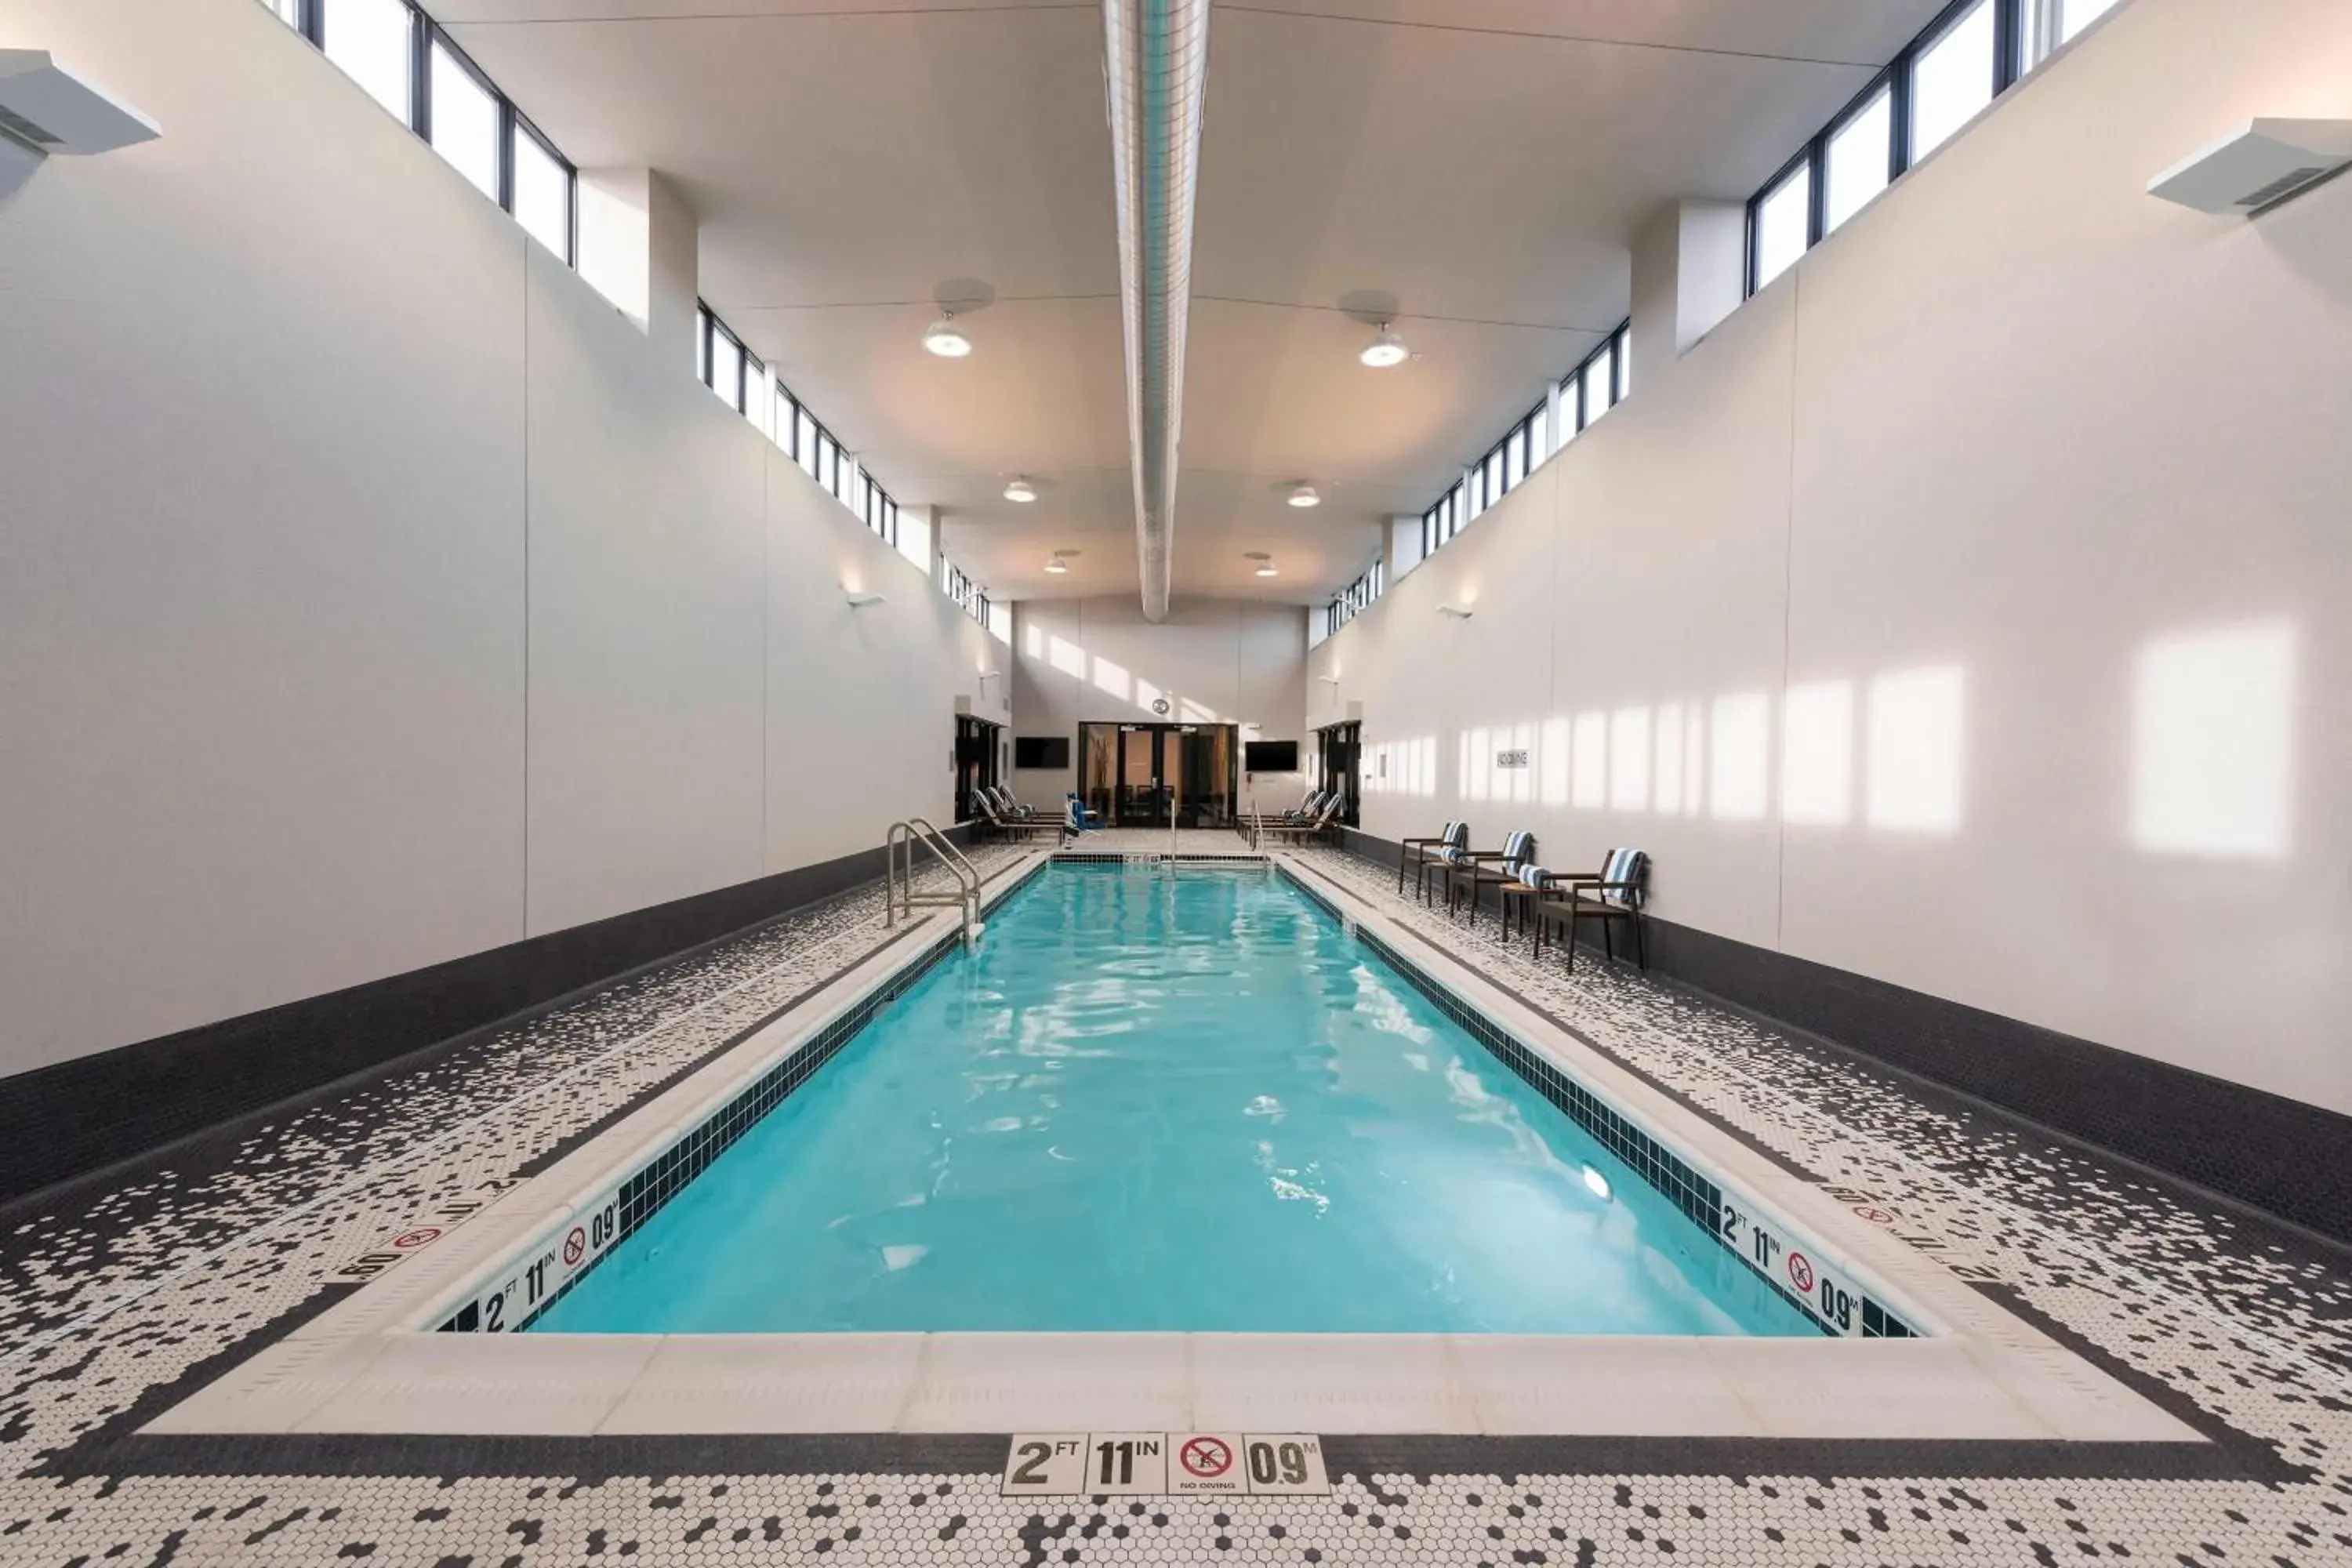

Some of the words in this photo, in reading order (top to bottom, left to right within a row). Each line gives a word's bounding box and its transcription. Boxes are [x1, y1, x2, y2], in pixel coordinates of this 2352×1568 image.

[1724, 1205, 1737, 1242] 2
[1753, 1225, 1769, 1267] 11
[526, 1259, 544, 1305] 11
[1011, 1442, 1052, 1484] 2
[1097, 1441, 1133, 1485] 11
[1136, 1441, 1159, 1456] IN
[1250, 1442, 1308, 1484] 0.9
